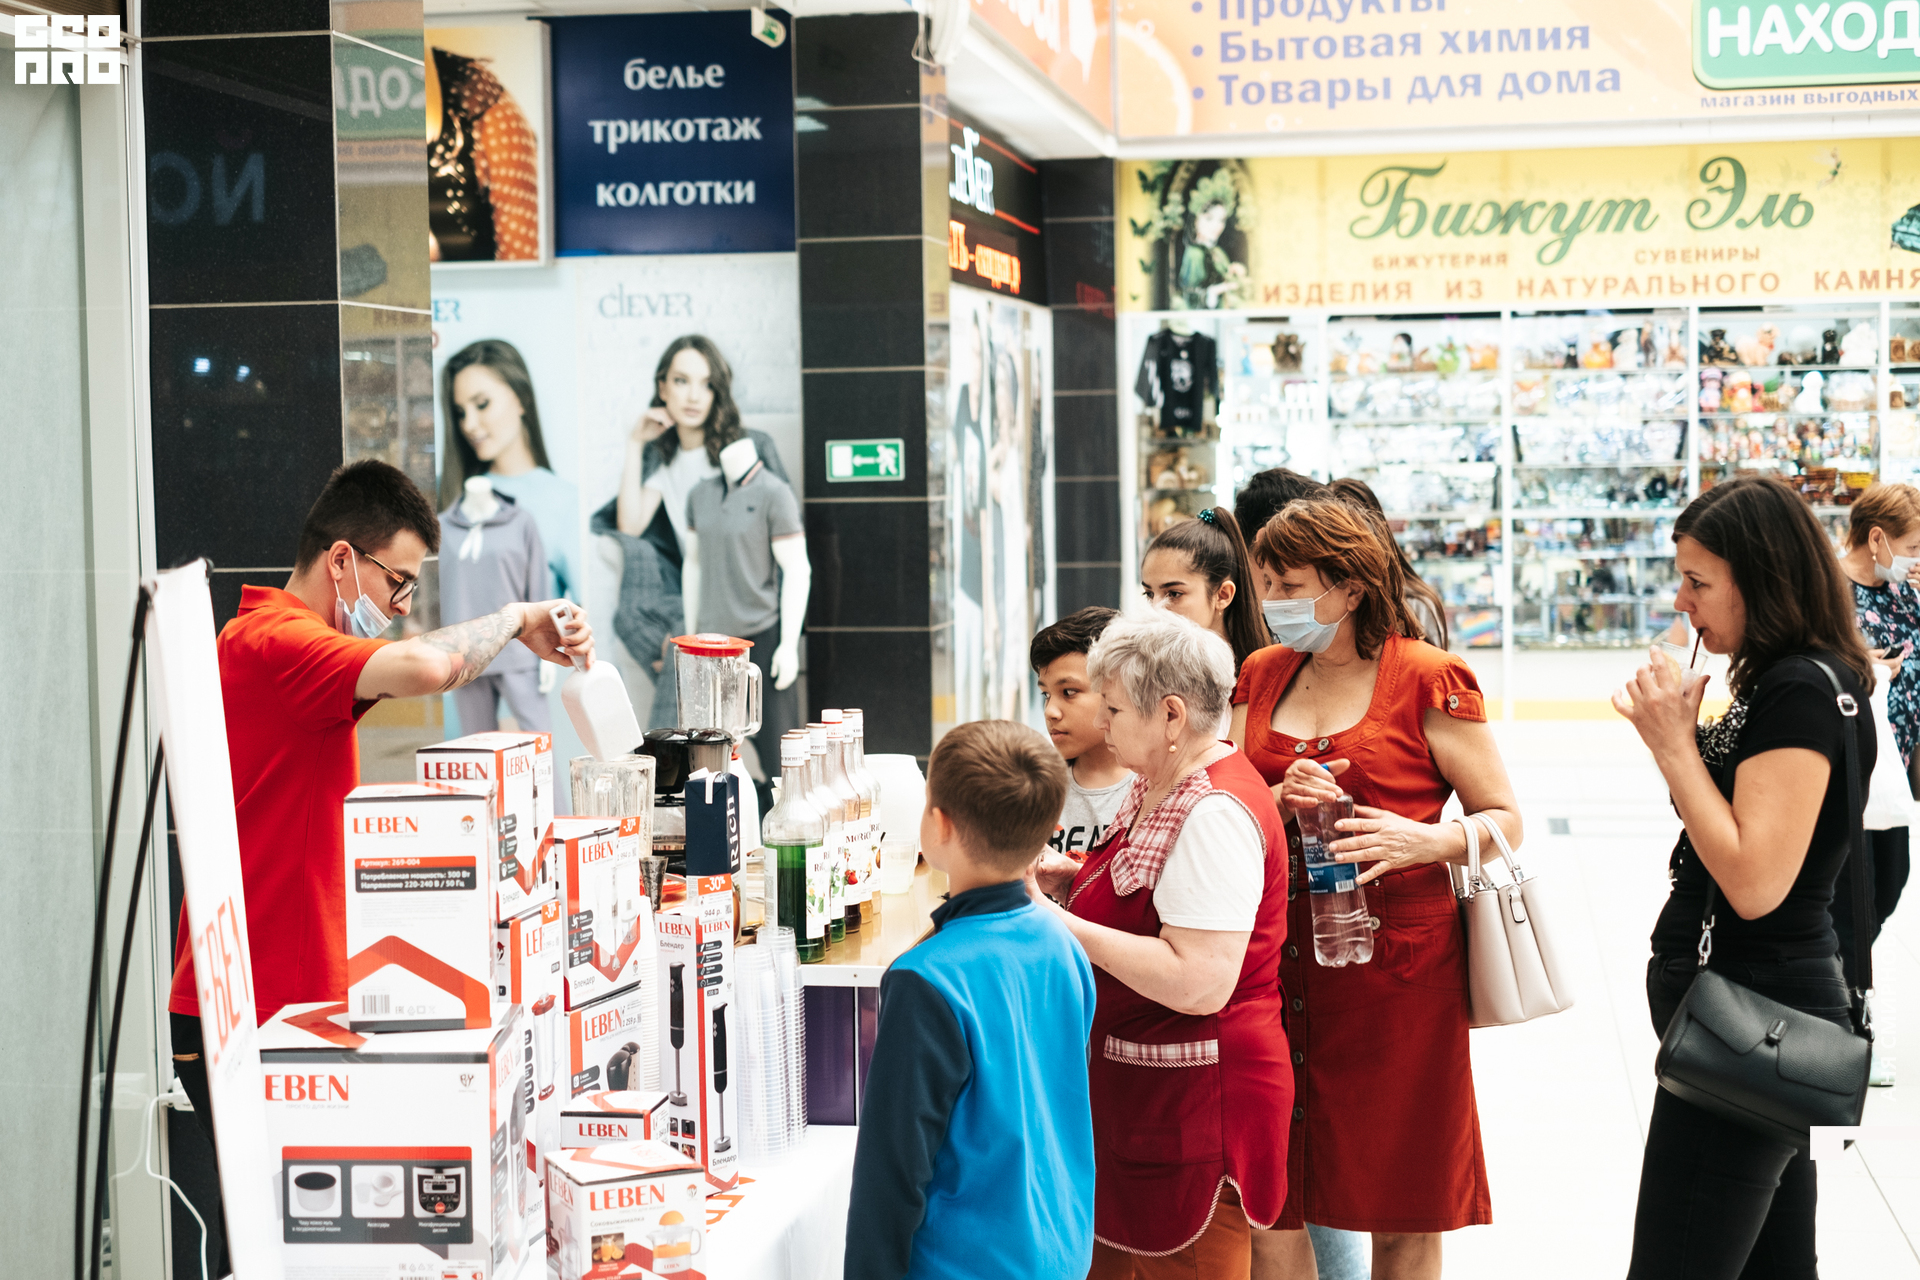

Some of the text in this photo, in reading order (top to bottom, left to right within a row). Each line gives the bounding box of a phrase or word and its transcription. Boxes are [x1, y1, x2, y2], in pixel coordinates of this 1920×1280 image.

[1707, 0, 1920, 59] НАХОД
[1220, 26, 1589, 63] Бытовая химия
[624, 57, 725, 90] белье
[1218, 68, 1620, 109] Товары для дома
[1701, 89, 1918, 109] магазин выгодных
[588, 117, 762, 154] трикотаж
[596, 180, 756, 207] колготки
[1350, 156, 1814, 266] Бижут Эль
[1373, 253, 1508, 269] БИЖУТЕРИЯ
[1635, 248, 1760, 265] СУВЕНИРЫ
[1263, 281, 1413, 307] ИЗДЕЛИЯ
[1446, 279, 1483, 299] ИЗ
[1517, 272, 1780, 297] НАТУРАЛЬНОГО
[424, 762, 488, 780] LEBEN
[506, 754, 530, 777] LEBEN
[353, 816, 418, 834] LEBEN
[727, 795, 739, 868] Rich
[1048, 825, 1112, 853] BEA
[582, 840, 613, 864] LEBEN
[404, 881, 433, 889] 220-240
[704, 876, 726, 892] -30%
[704, 908, 715, 917] 944
[659, 921, 692, 937] LEBEN
[704, 920, 730, 934] LEBEN
[659, 940, 685, 951] Блендер
[574, 975, 595, 990] Блендер
[584, 1008, 622, 1042] LEBEN
[265, 1074, 349, 1101] EBEN
[579, 1123, 628, 1137] LEBEN
[712, 1154, 738, 1167] Блендер
[550, 1173, 573, 1206] LEBEN
[590, 1183, 665, 1211] LEBEN
[590, 1216, 645, 1228] Соковыжималка
